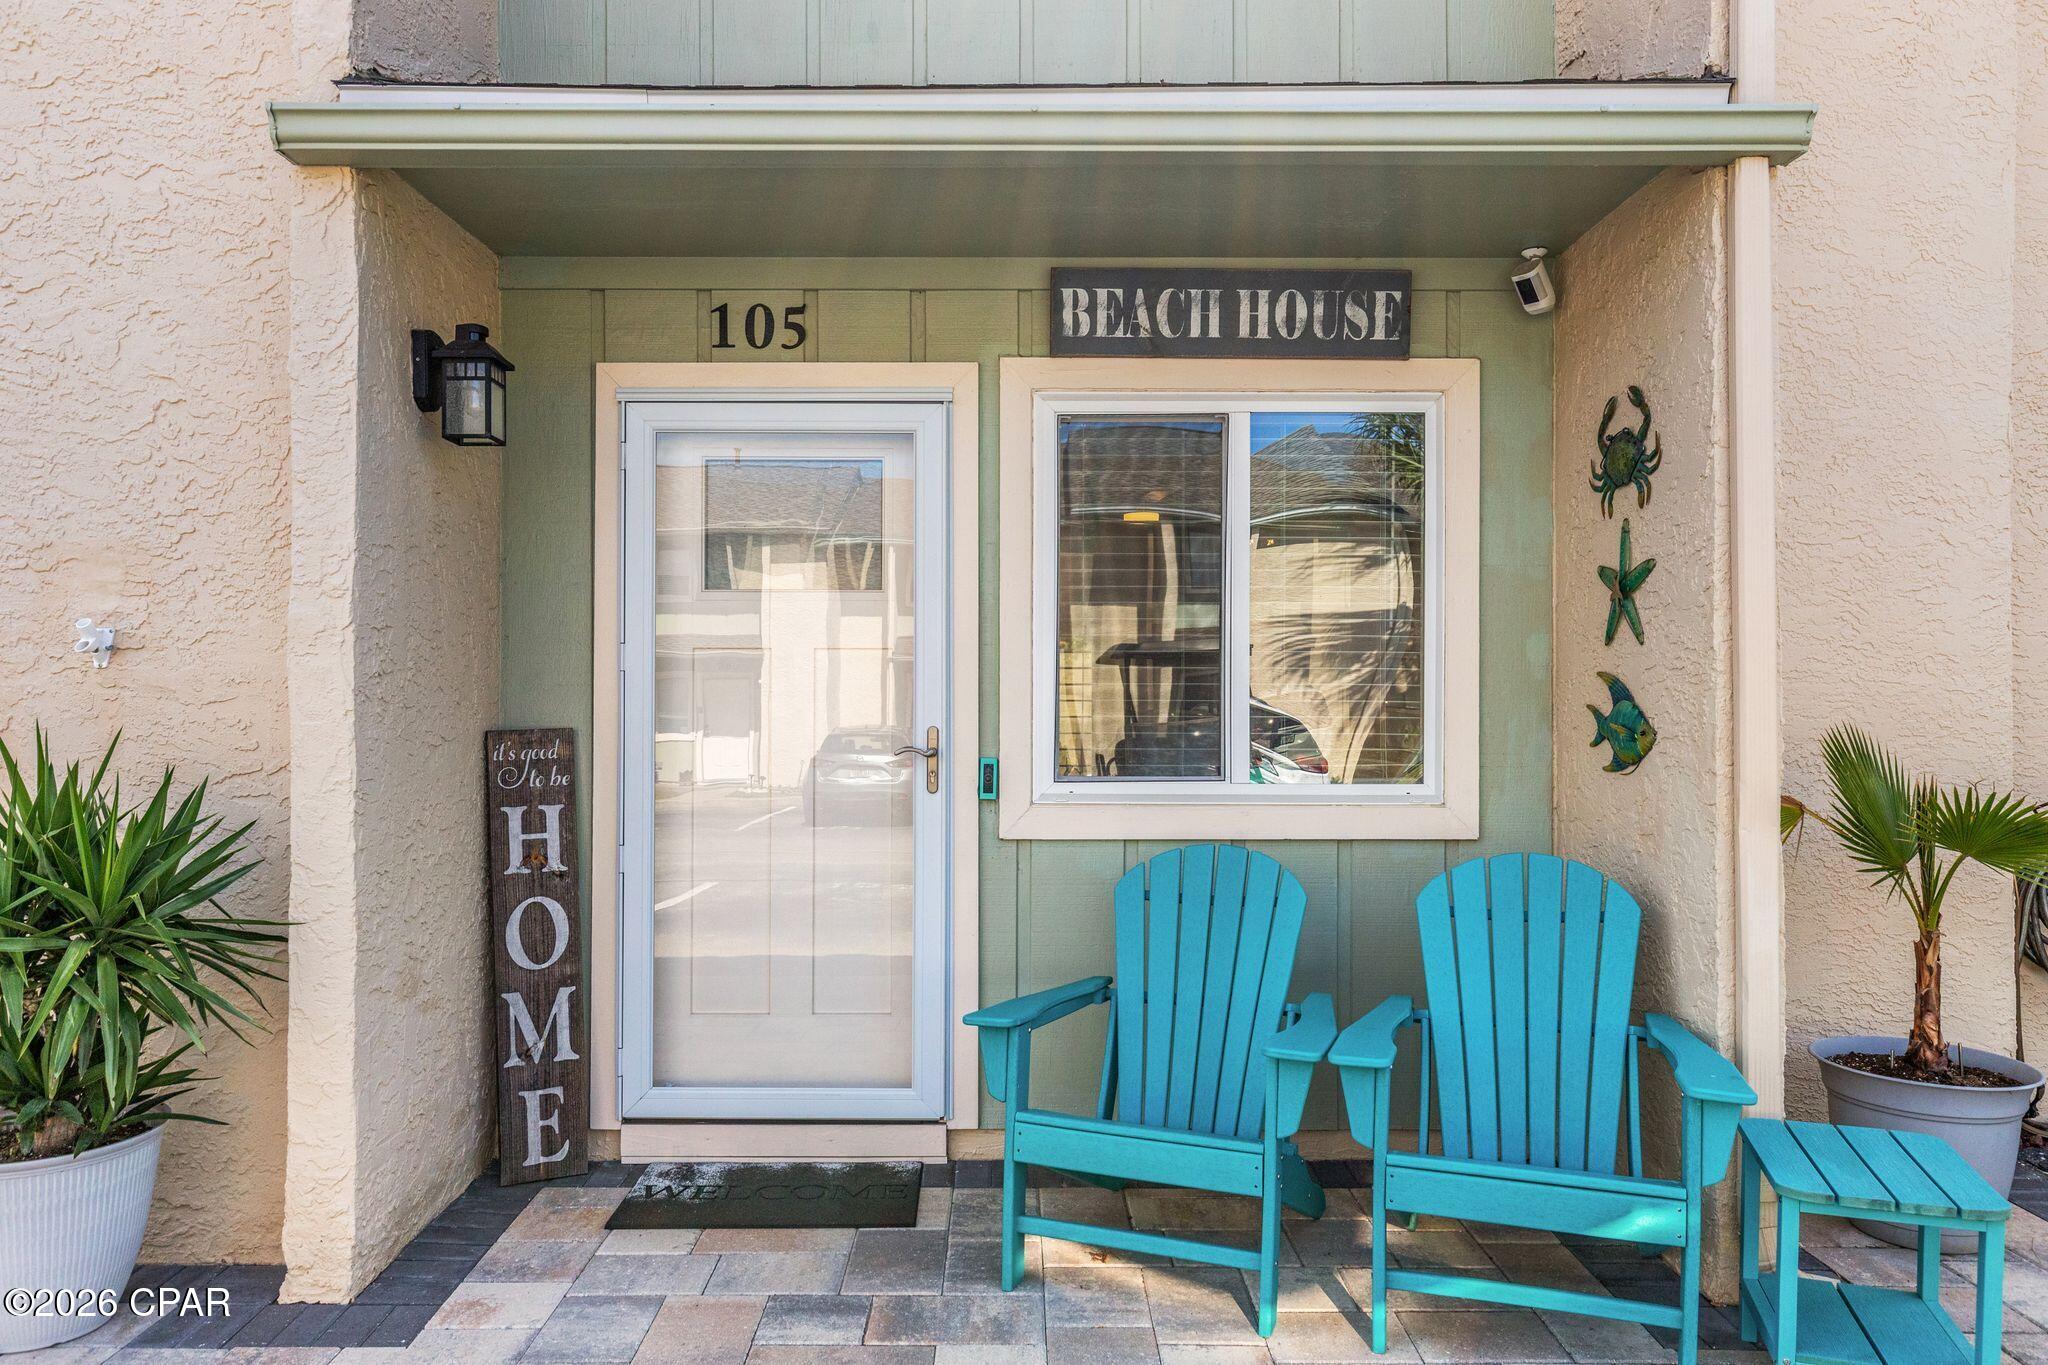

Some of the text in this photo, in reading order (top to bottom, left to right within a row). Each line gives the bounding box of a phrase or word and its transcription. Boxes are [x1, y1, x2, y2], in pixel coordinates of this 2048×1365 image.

[710, 302, 806, 349] 105
[1060, 288, 1402, 341] BEACH HOUSE
[493, 741, 516, 761] it's
[529, 765, 571, 788] to be
[500, 803, 580, 1167] HOME
[643, 1184, 909, 1201] WELCOME
